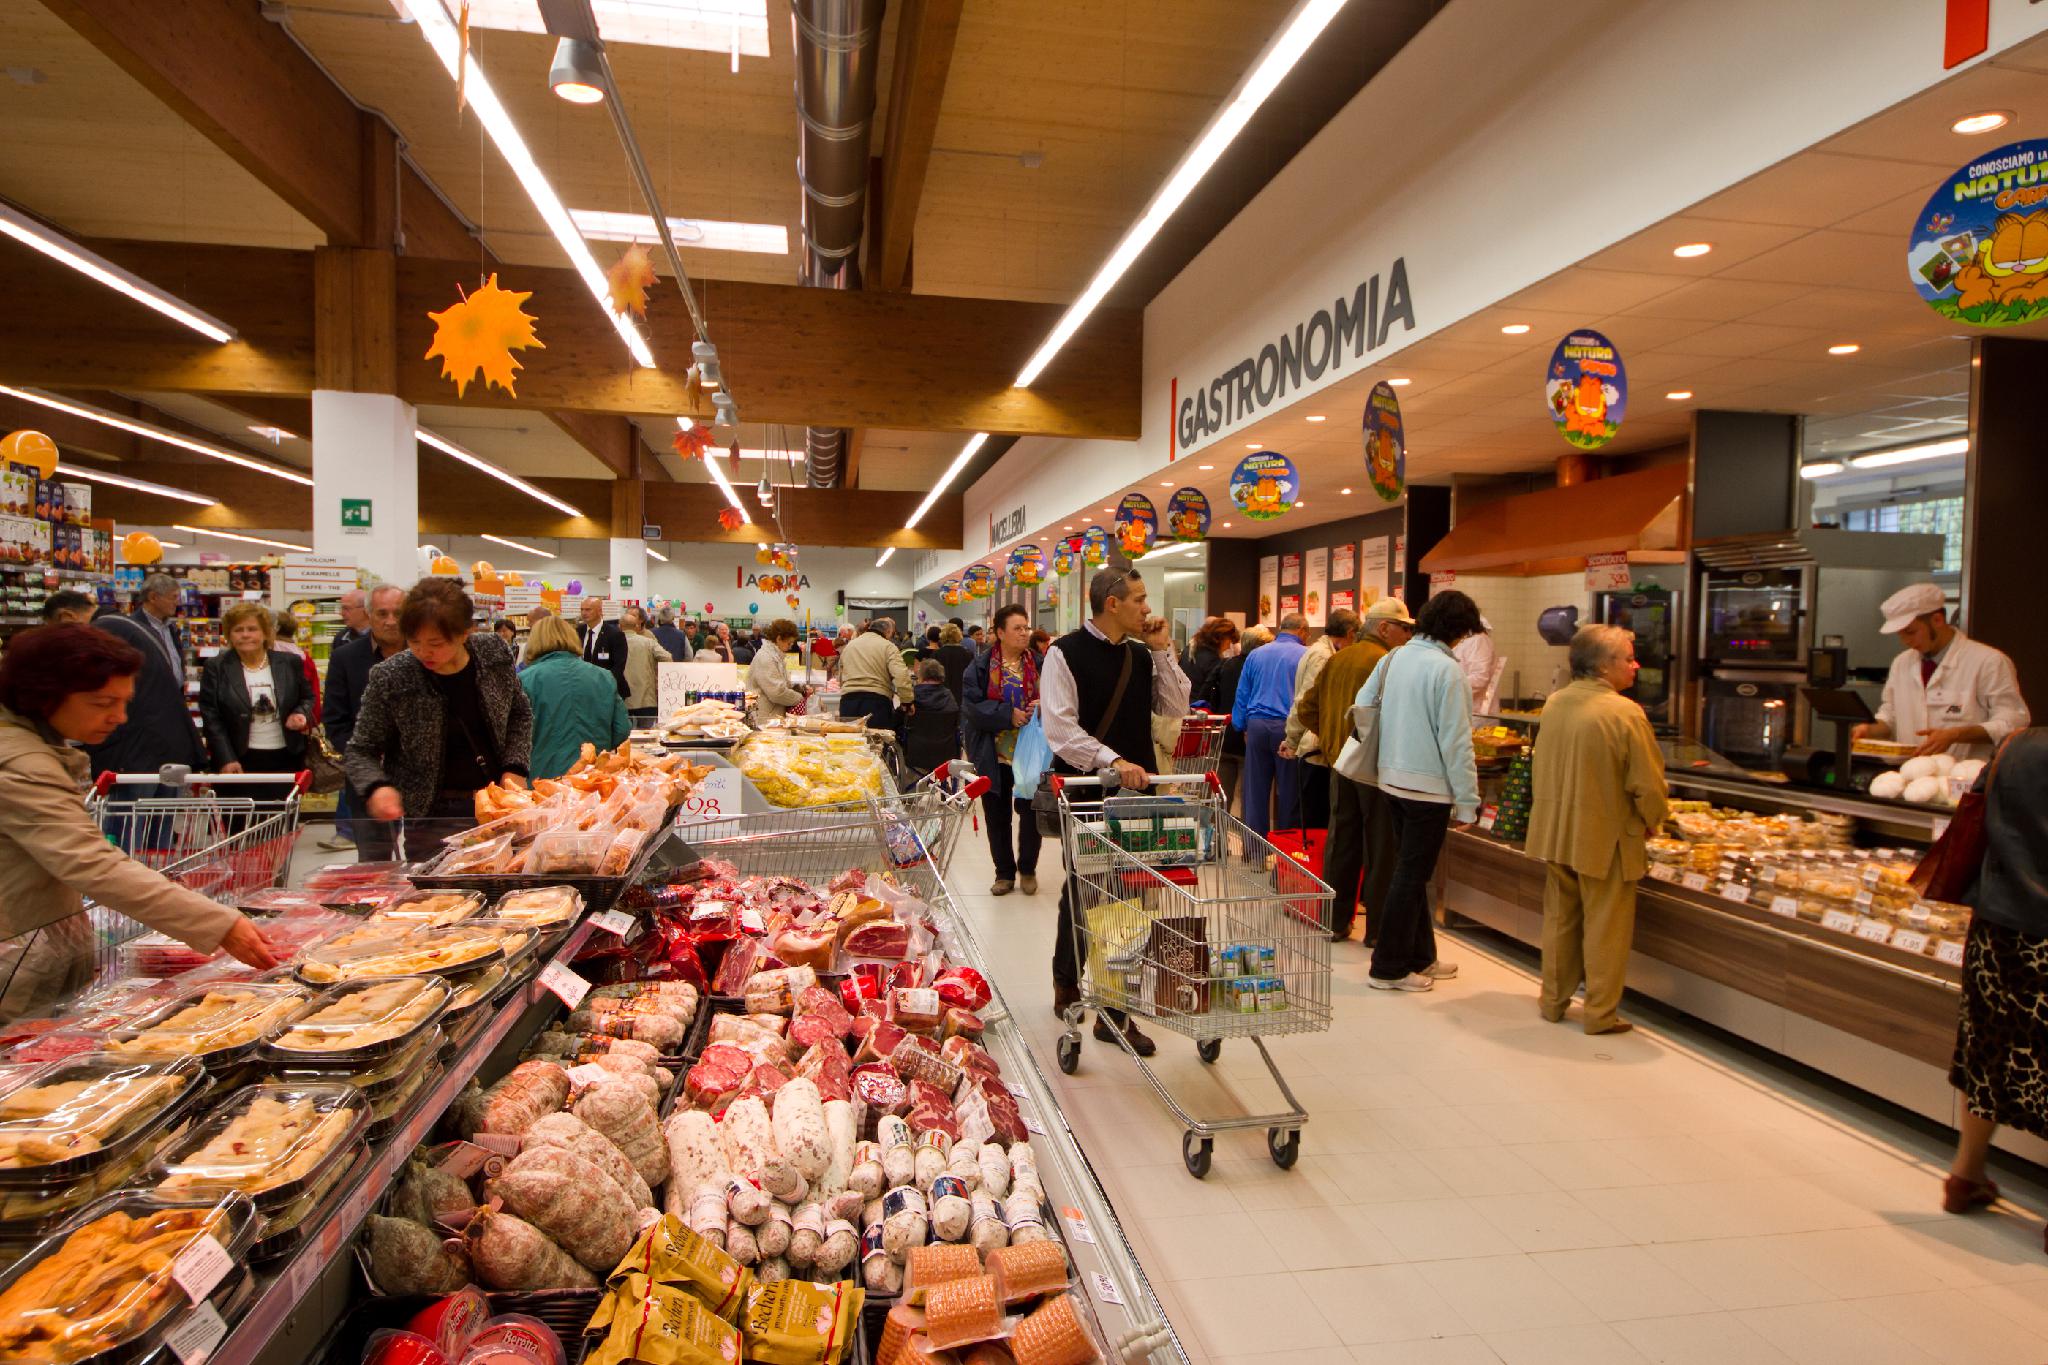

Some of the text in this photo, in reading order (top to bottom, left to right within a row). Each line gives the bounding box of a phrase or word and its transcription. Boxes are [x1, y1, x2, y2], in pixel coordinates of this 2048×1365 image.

[1968, 150, 2035, 179] CONOSCIAMO
[1177, 256, 1416, 451] GASTRONOMIA
[502, 1329, 539, 1354] Beretta
